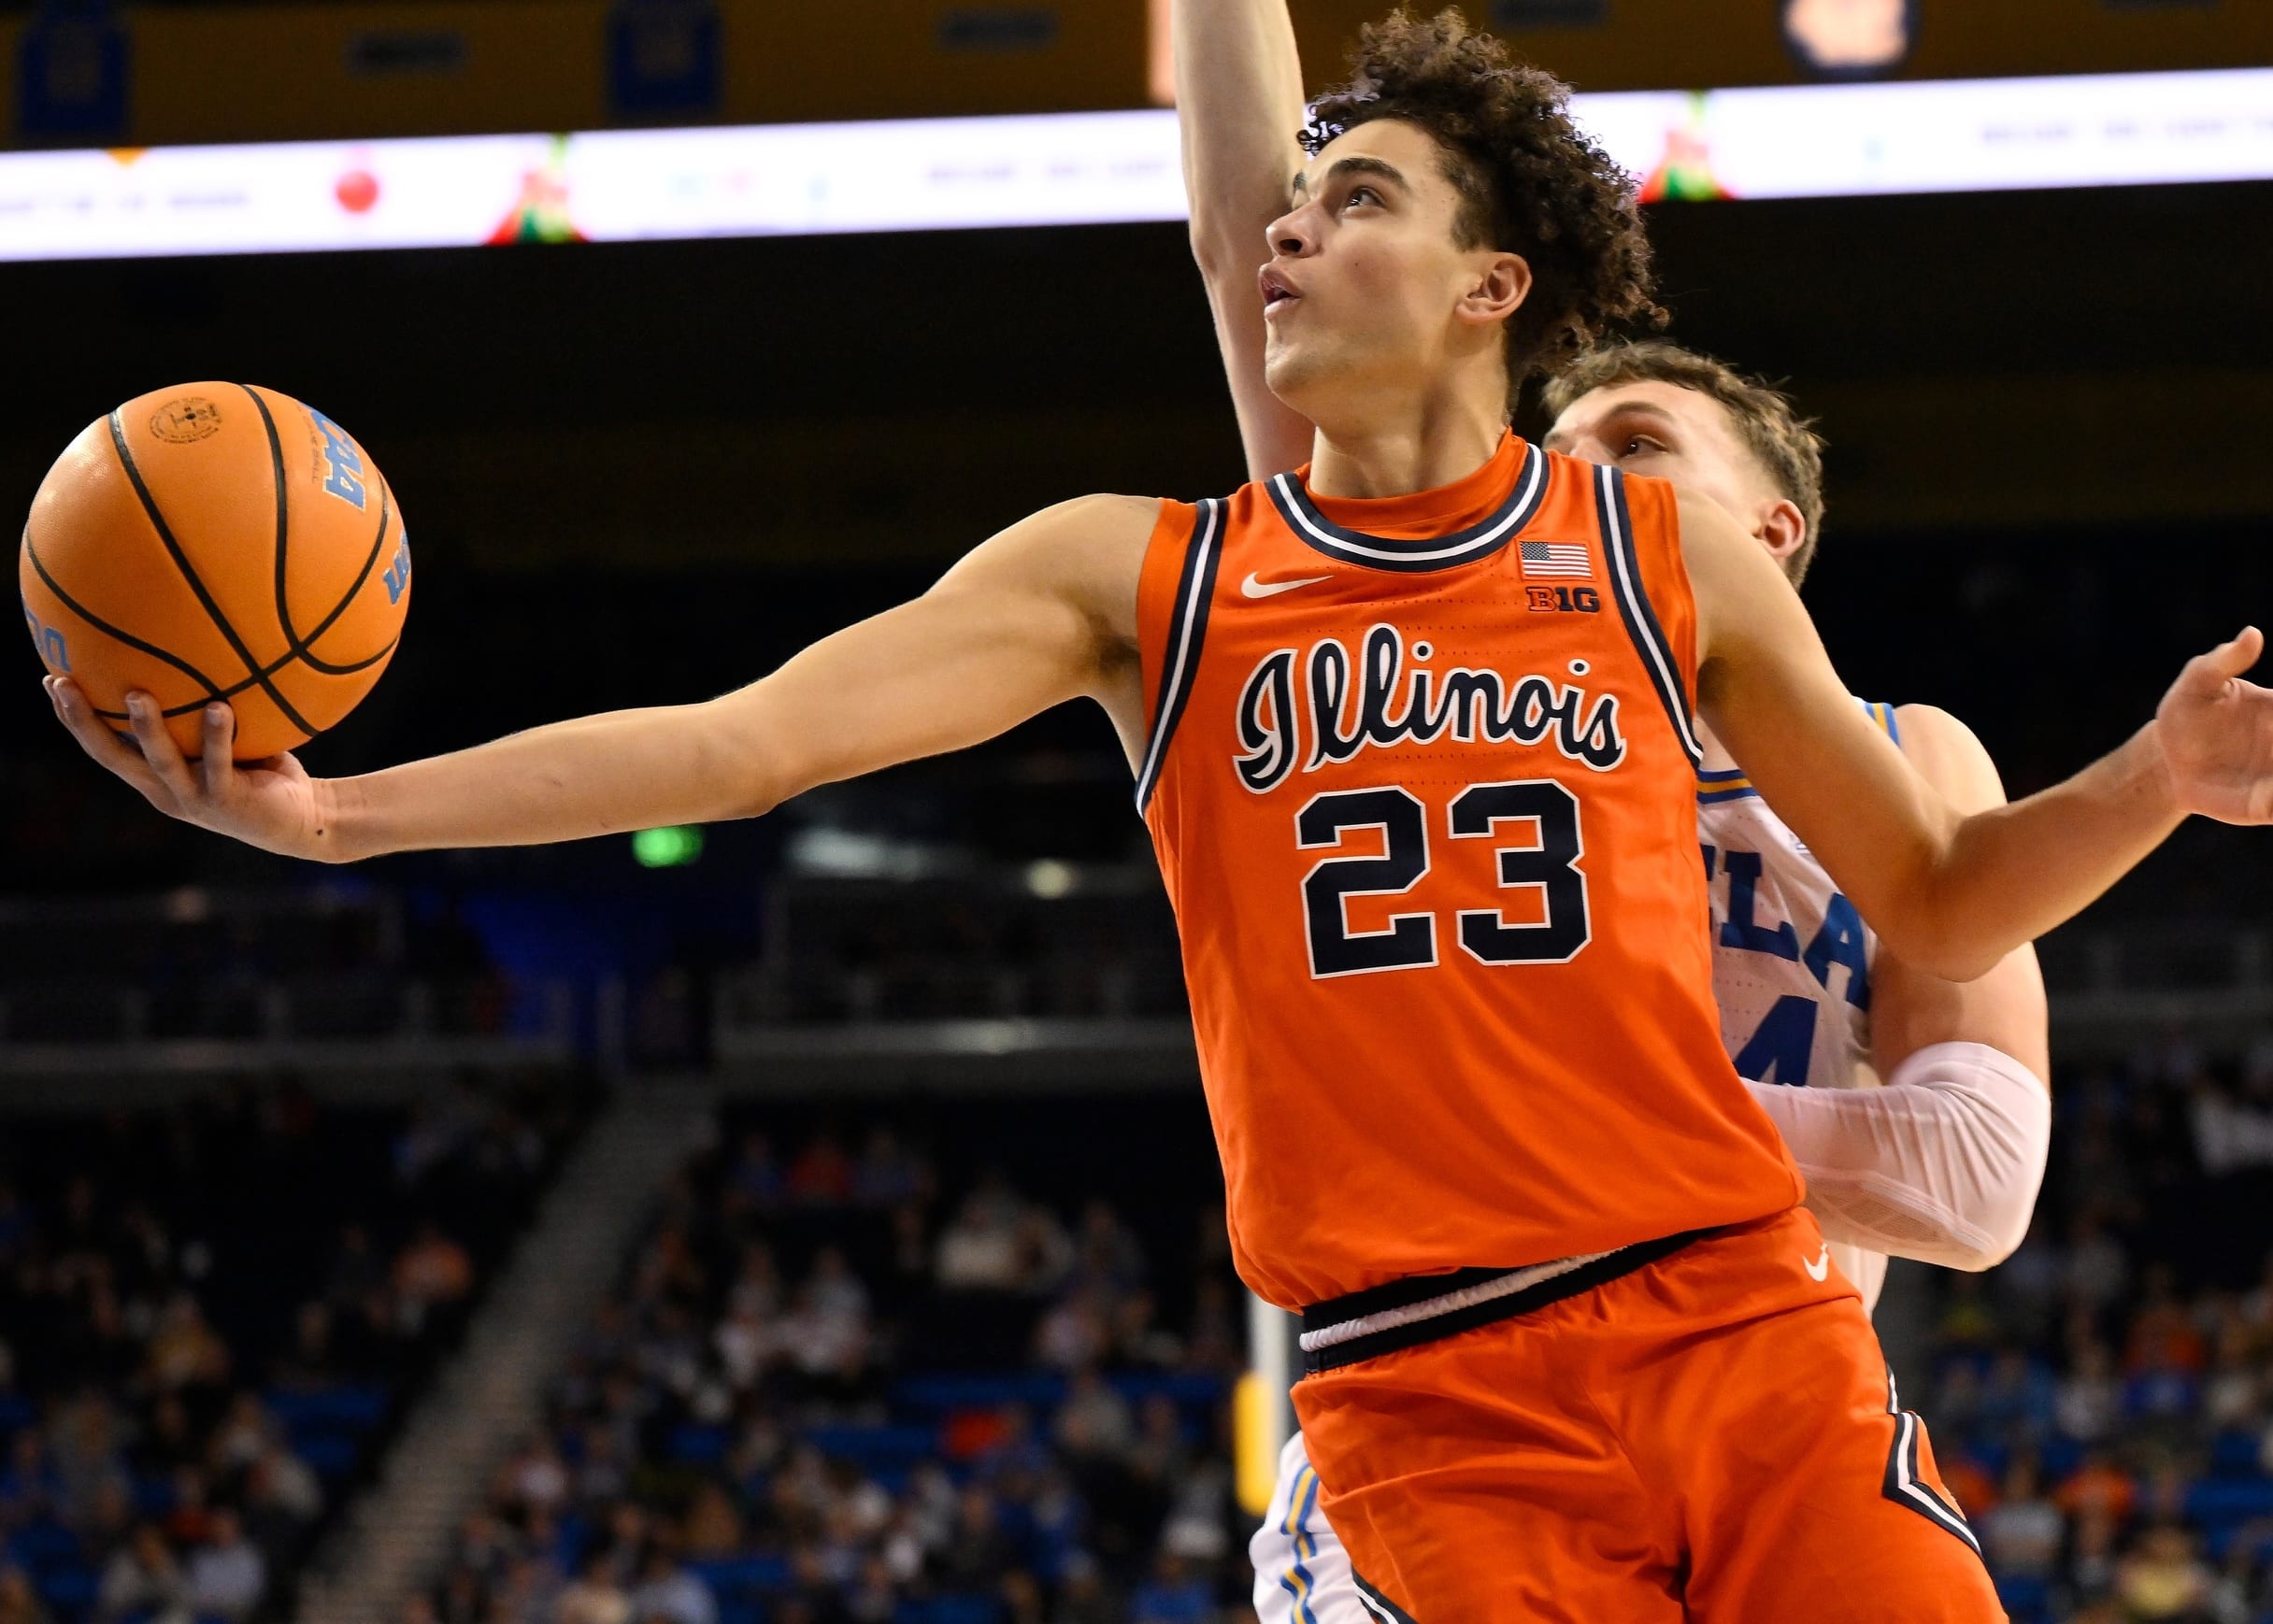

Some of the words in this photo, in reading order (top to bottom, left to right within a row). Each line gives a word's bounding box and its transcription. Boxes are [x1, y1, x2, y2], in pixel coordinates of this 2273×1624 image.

[299, 402, 365, 512] CAA
[1232, 622, 1627, 794] Illinois
[1294, 779, 1592, 979] 23
[1699, 844, 1869, 1012] LA
